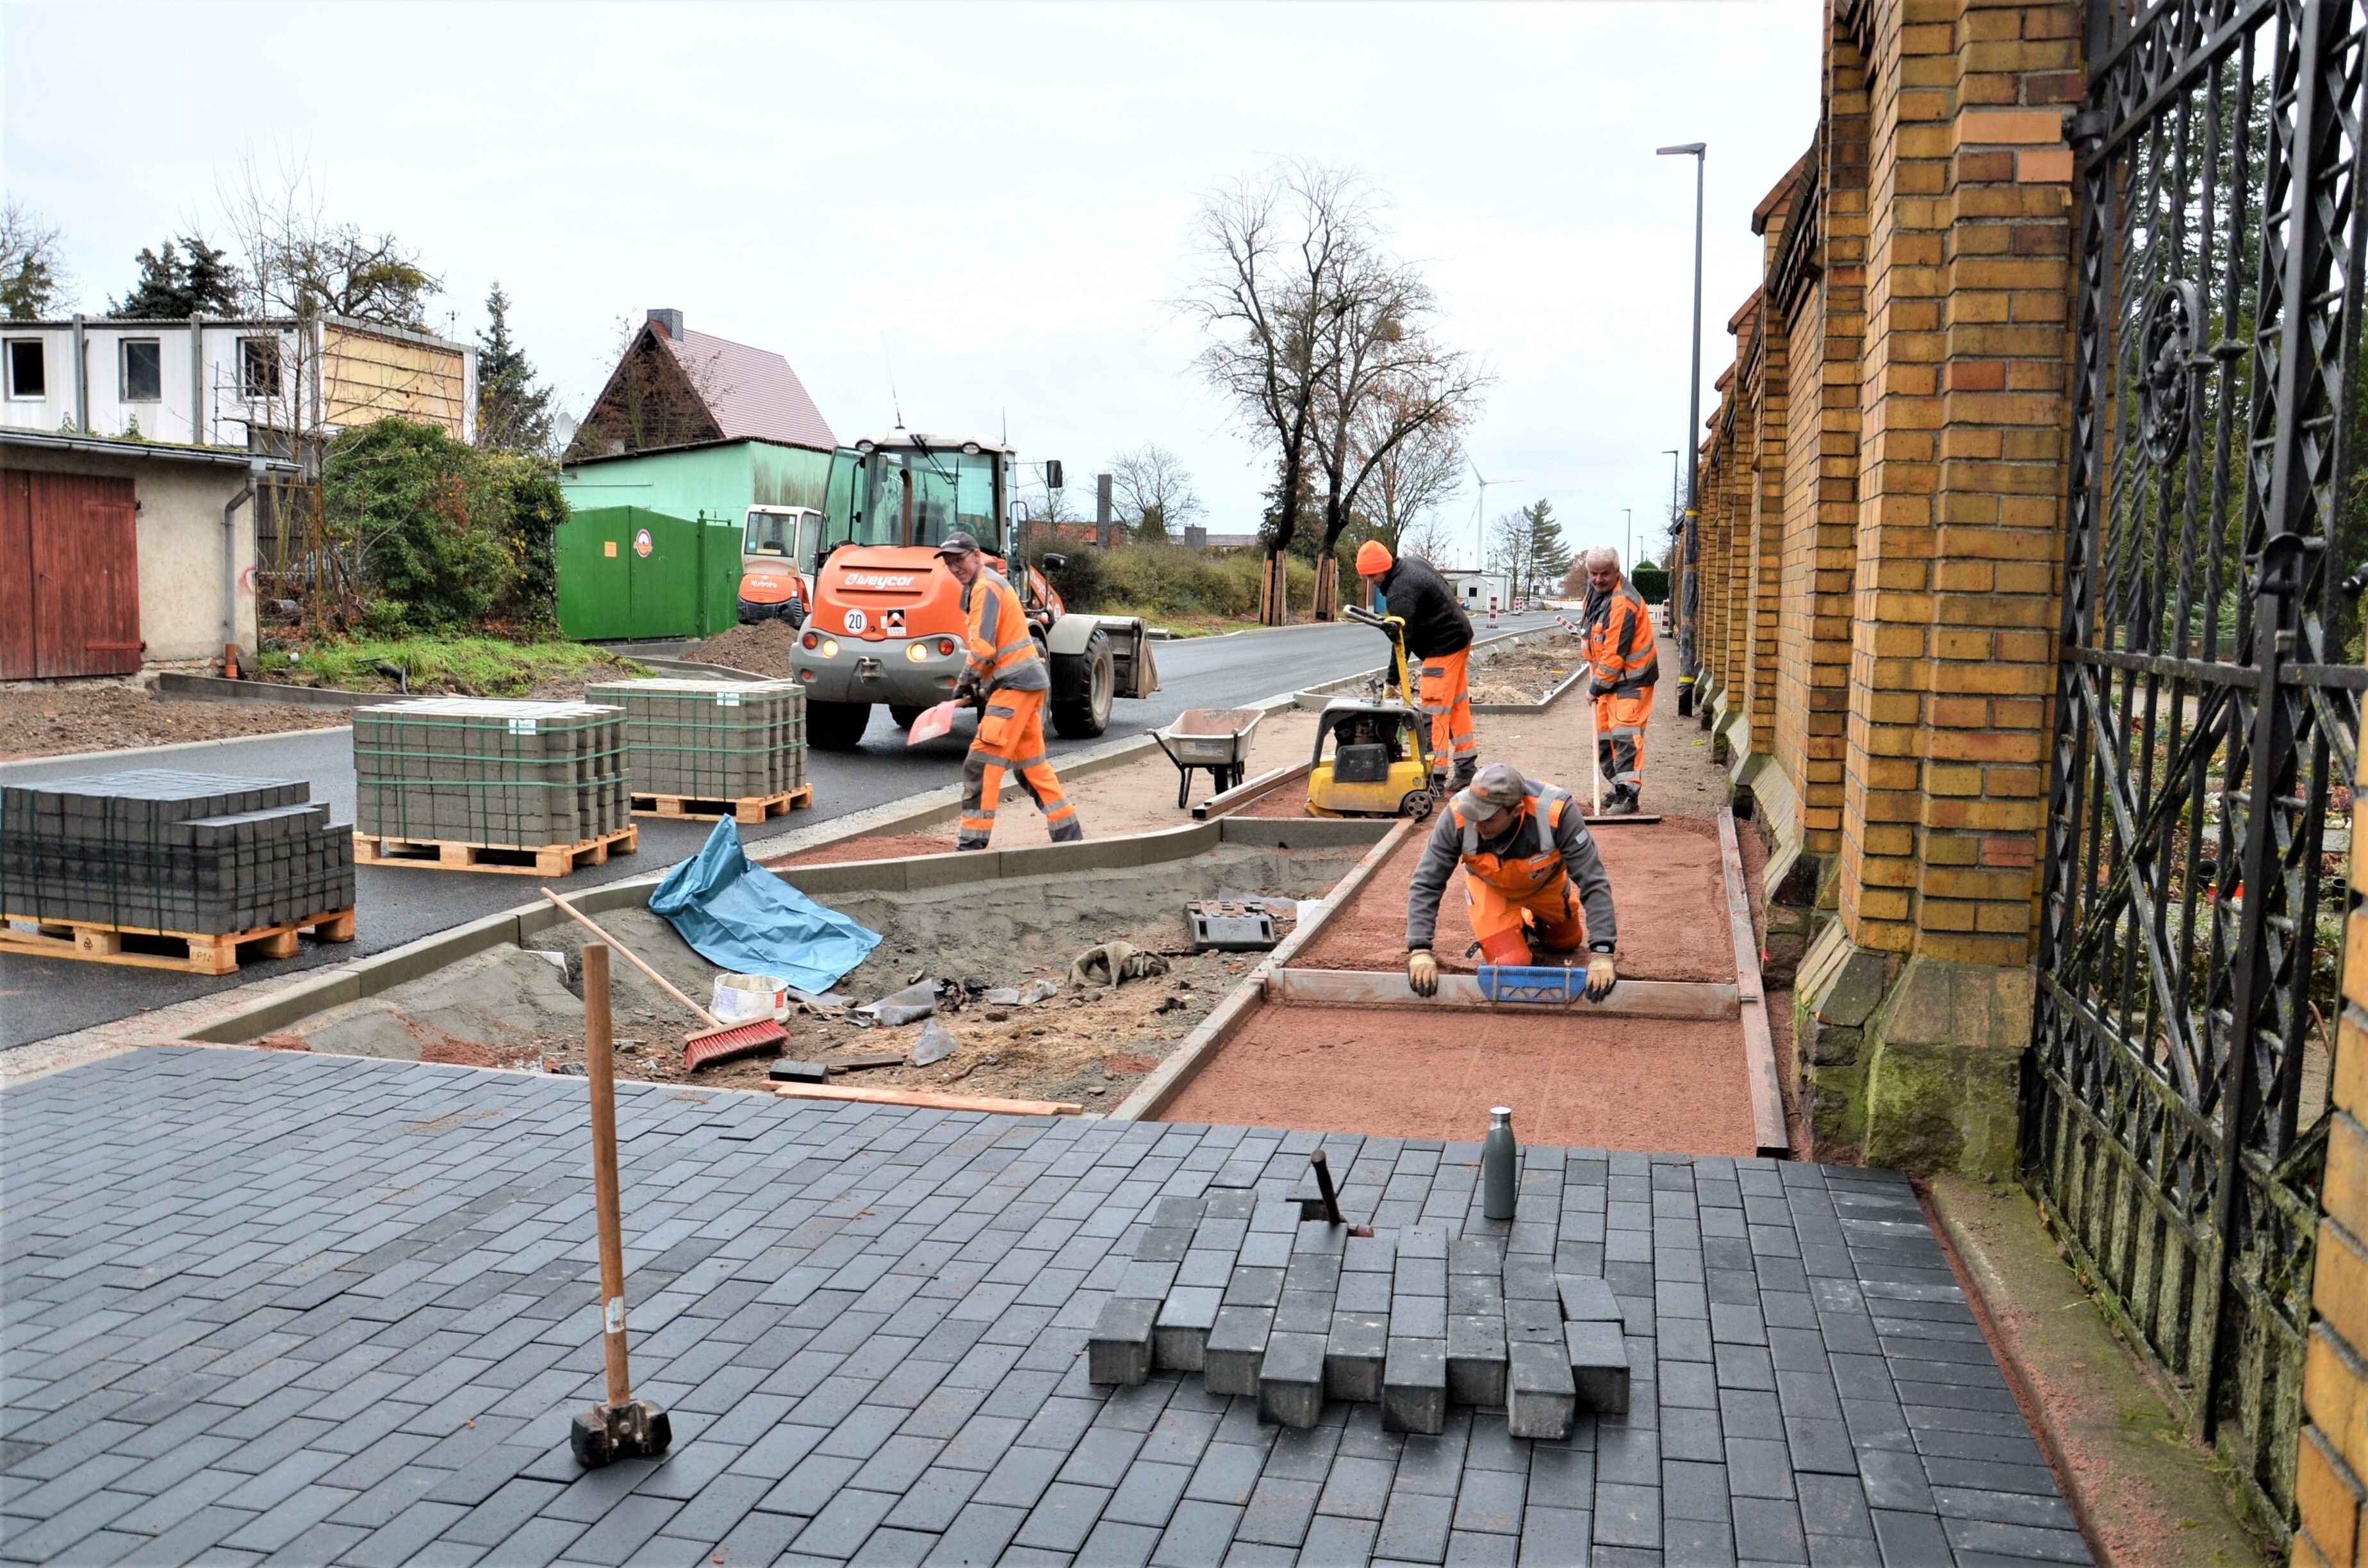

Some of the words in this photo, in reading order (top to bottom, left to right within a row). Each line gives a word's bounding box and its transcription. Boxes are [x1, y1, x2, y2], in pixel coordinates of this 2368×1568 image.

[750, 580, 777, 588] Kubota
[856, 575, 915, 589] weycor
[849, 614, 862, 629] 20
